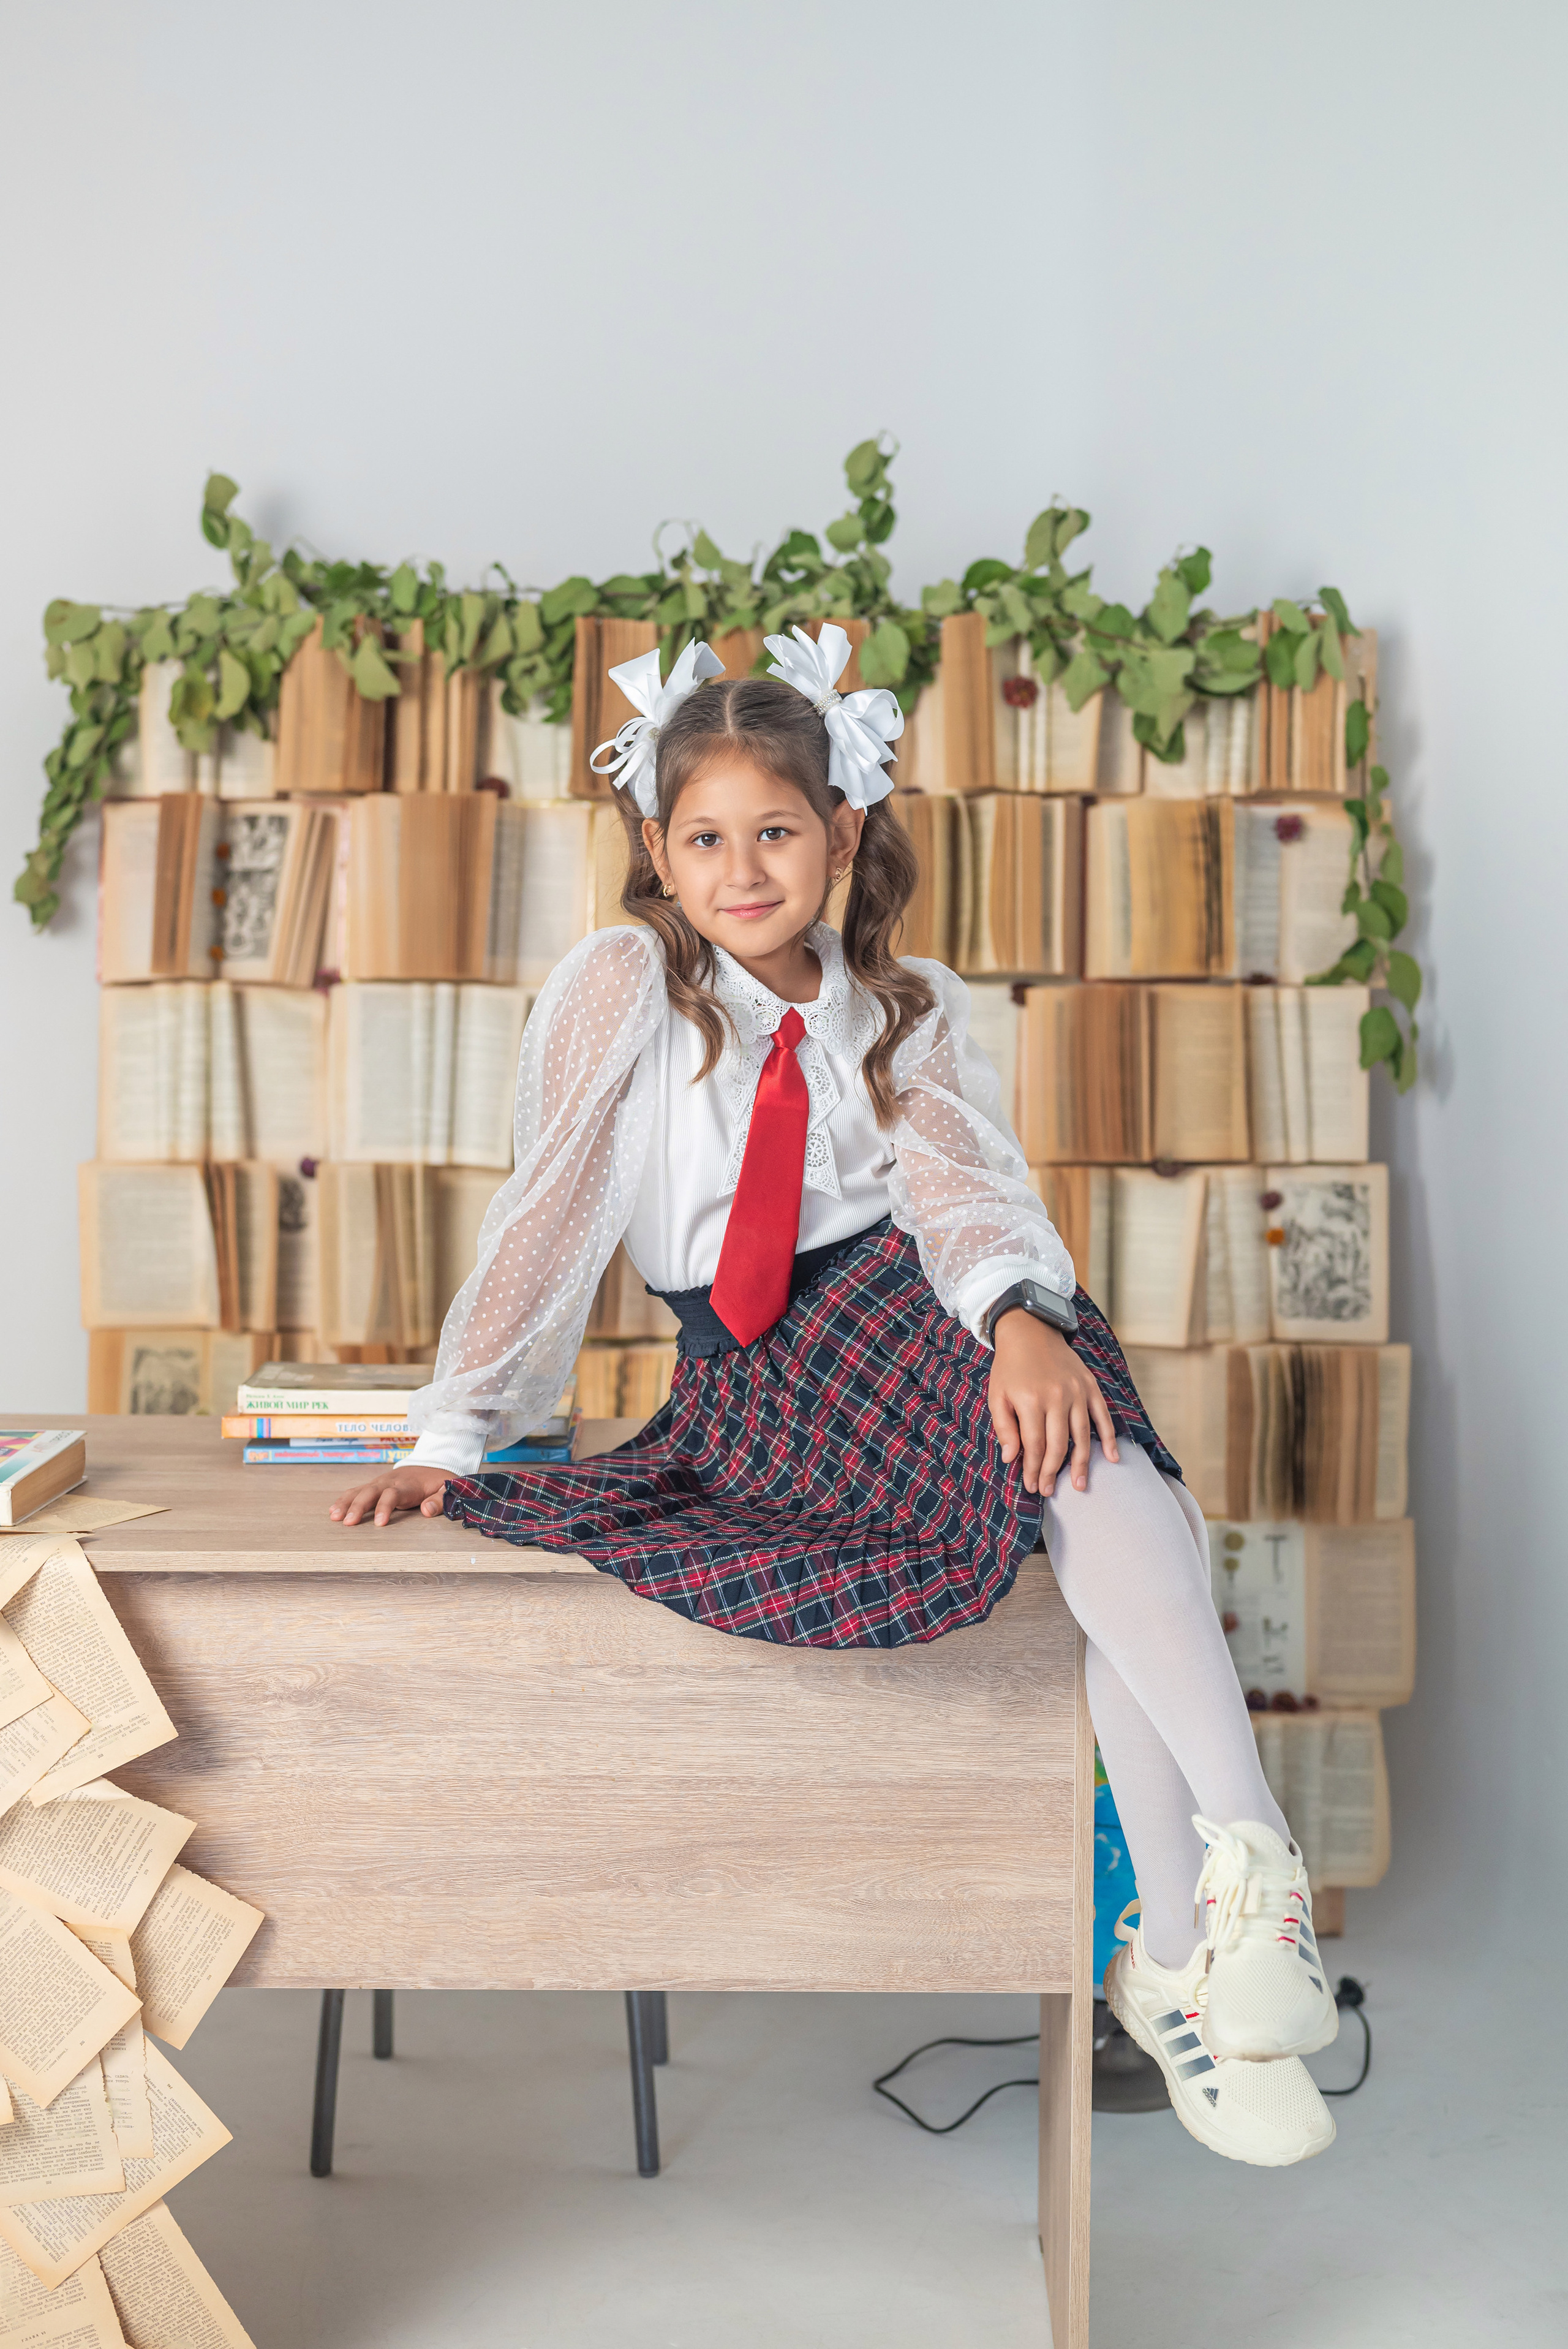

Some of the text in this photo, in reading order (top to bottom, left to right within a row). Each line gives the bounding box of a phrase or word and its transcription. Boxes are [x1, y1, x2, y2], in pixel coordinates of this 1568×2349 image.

[246, 1400, 284, 1409] ЖИВОЙ
[312, 1401, 329, 1410] РЕК
[337, 1423, 366, 1432] ТЕЛО
[40, 1585, 54, 1595] шитый
[62, 1580, 75, 1589] благо-
[26, 1613, 42, 1624] дарить?
[50, 1725, 59, 1734] при-
[39, 1734, 49, 1744] Мас-
[99, 1846, 114, 1870] расстанемся
[83, 1896, 91, 1908] шафт
[98, 1867, 107, 1880] будем
[138, 1964, 149, 1978] хотели
[146, 1953, 156, 1964] взять
[178, 1895, 192, 1914] господин
[156, 1962, 167, 1975] После
[165, 1950, 174, 1961] этого
[173, 1933, 185, 1950] мамаша
[195, 1902, 204, 1913] вста-
[181, 1989, 194, 2005] простил
[192, 1978, 202, 1989] меня;
[200, 1964, 209, 1978] скажи
[46, 2030, 64, 2049] существуем
[91, 1988, 103, 2000] сущест-
[55, 2035, 66, 2046] может
[66, 2016, 84, 2035] куда-нибудь
[1202, 2087, 1218, 2108] adidas
[170, 2098, 186, 2114] мучается!
[179, 2114, 195, 2132] перестает
[31, 2201, 42, 2214] такого
[43, 2225, 53, 2233] нет?
[108, 2241, 127, 2253] Николая
[151, 2236, 163, 2244] после
[37, 2290, 59, 2301] назначено
[62, 2282, 82, 2292] свидание
[147, 2296, 158, 2305] дому
[169, 2278, 190, 2292] поминутно
[26, 2301, 43, 2310] отъезда
[135, 2312, 150, 2322] сегодня
[151, 2304, 164, 2313] утром
[164, 2294, 180, 2306] заперся
[21, 2334, 39, 2343] ГЛАВА
